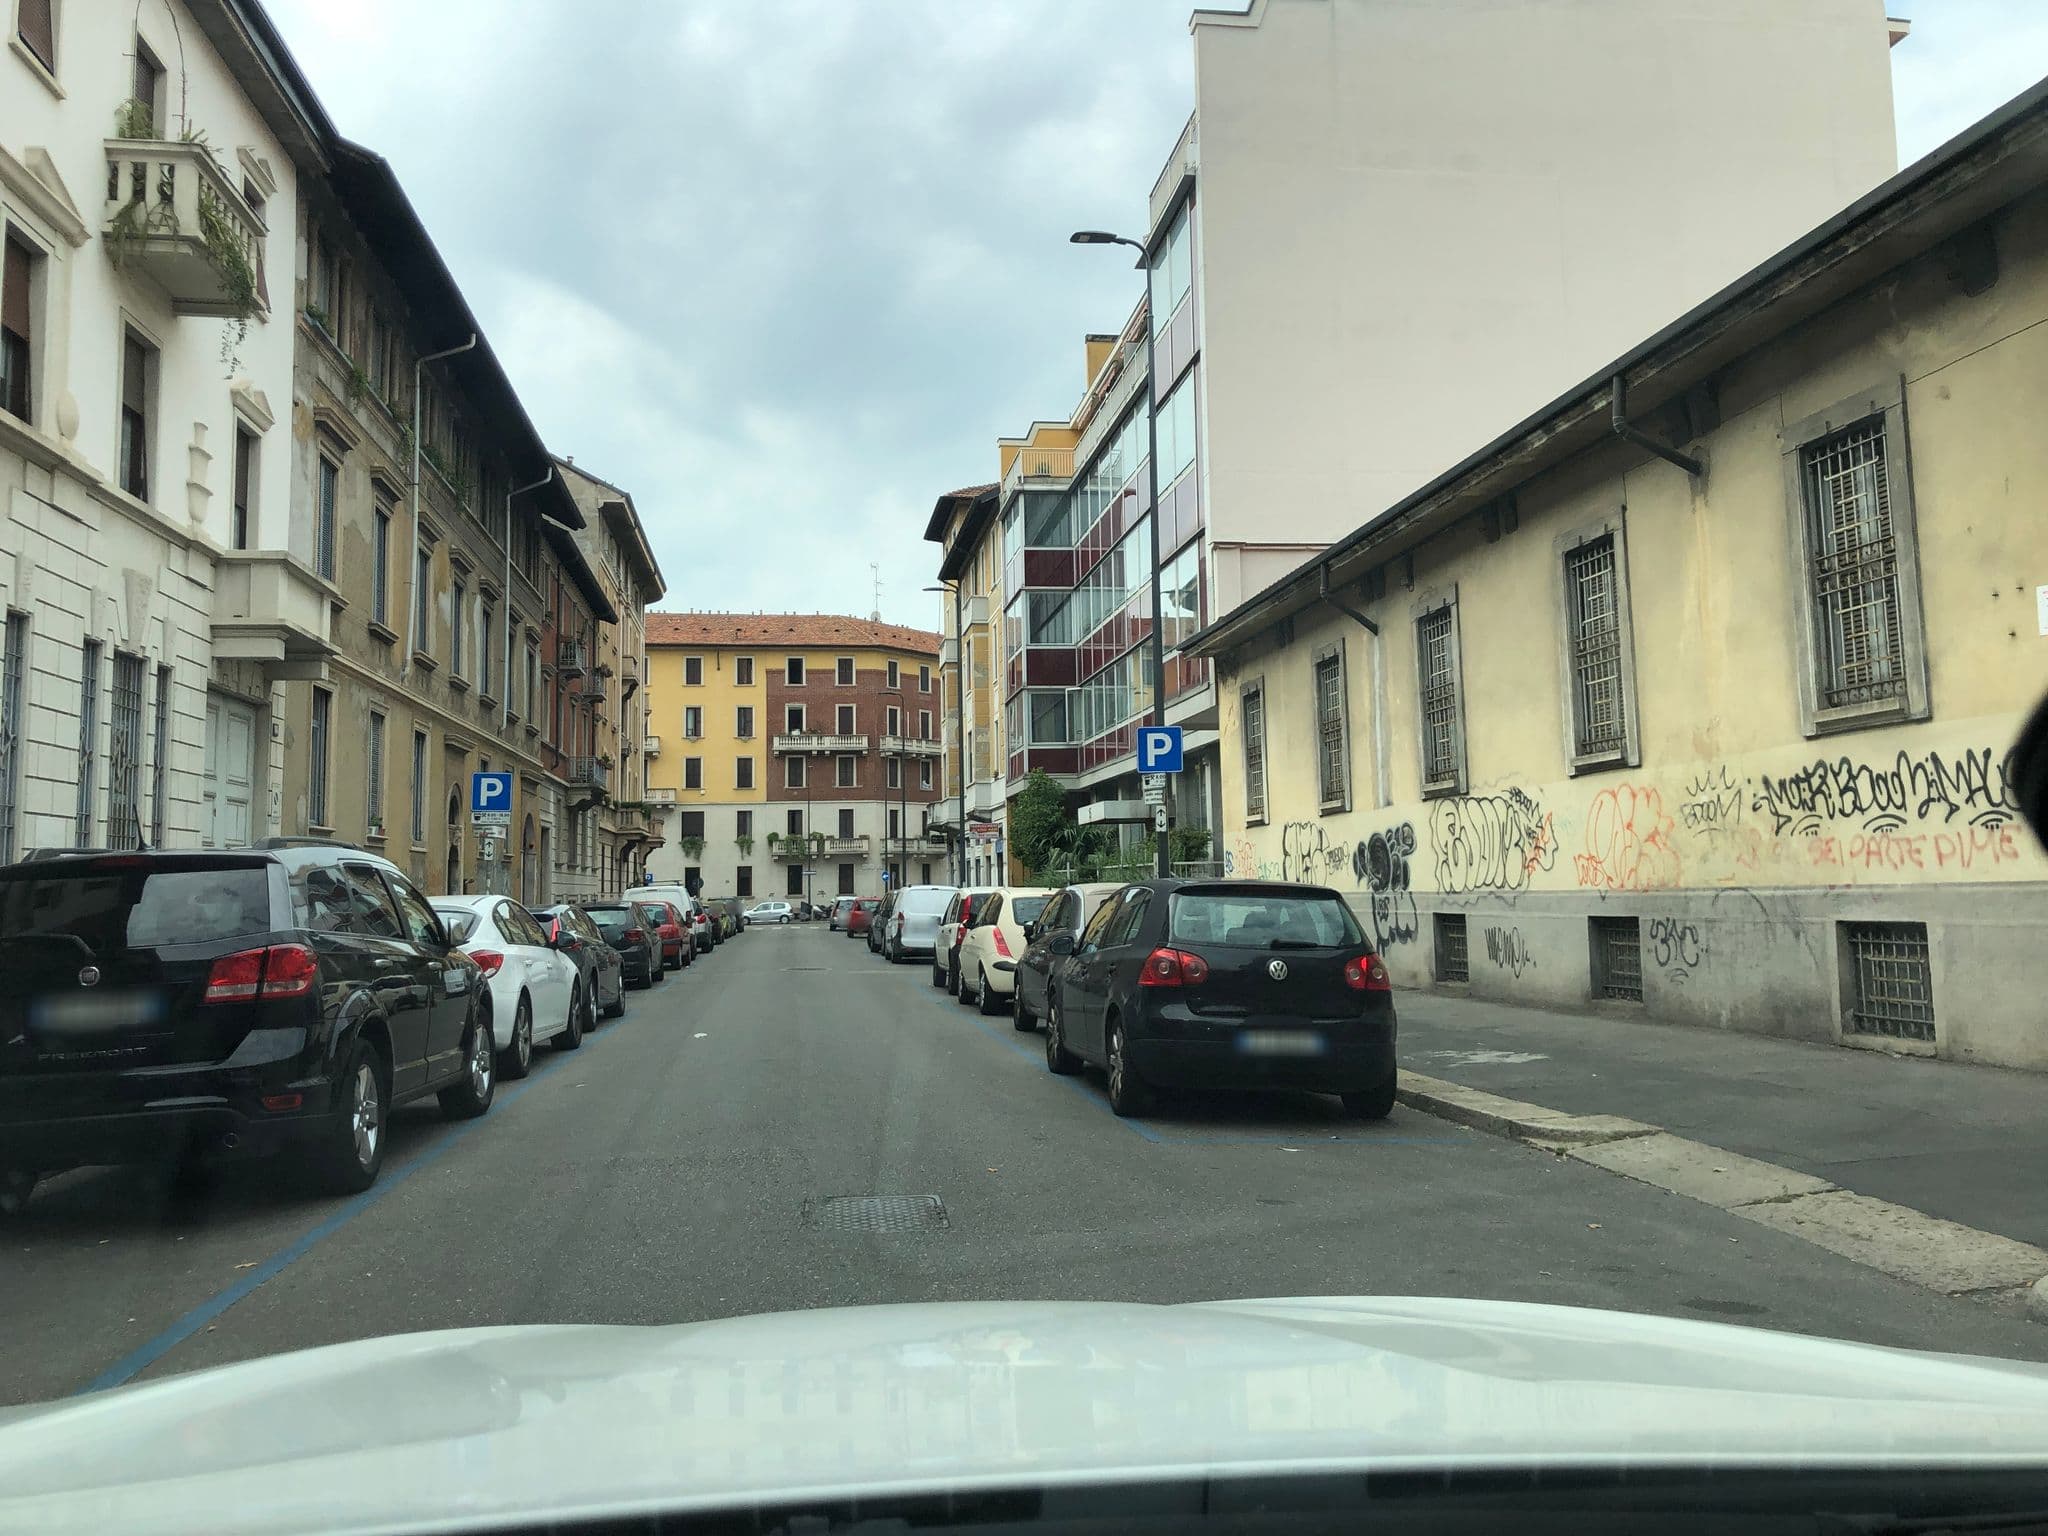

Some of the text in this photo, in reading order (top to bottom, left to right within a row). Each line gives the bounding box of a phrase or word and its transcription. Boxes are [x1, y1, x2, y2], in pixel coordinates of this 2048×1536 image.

[1146, 732, 1173, 767] P
[480, 777, 503, 806] P
[1850, 832, 1927, 870] PARTE
